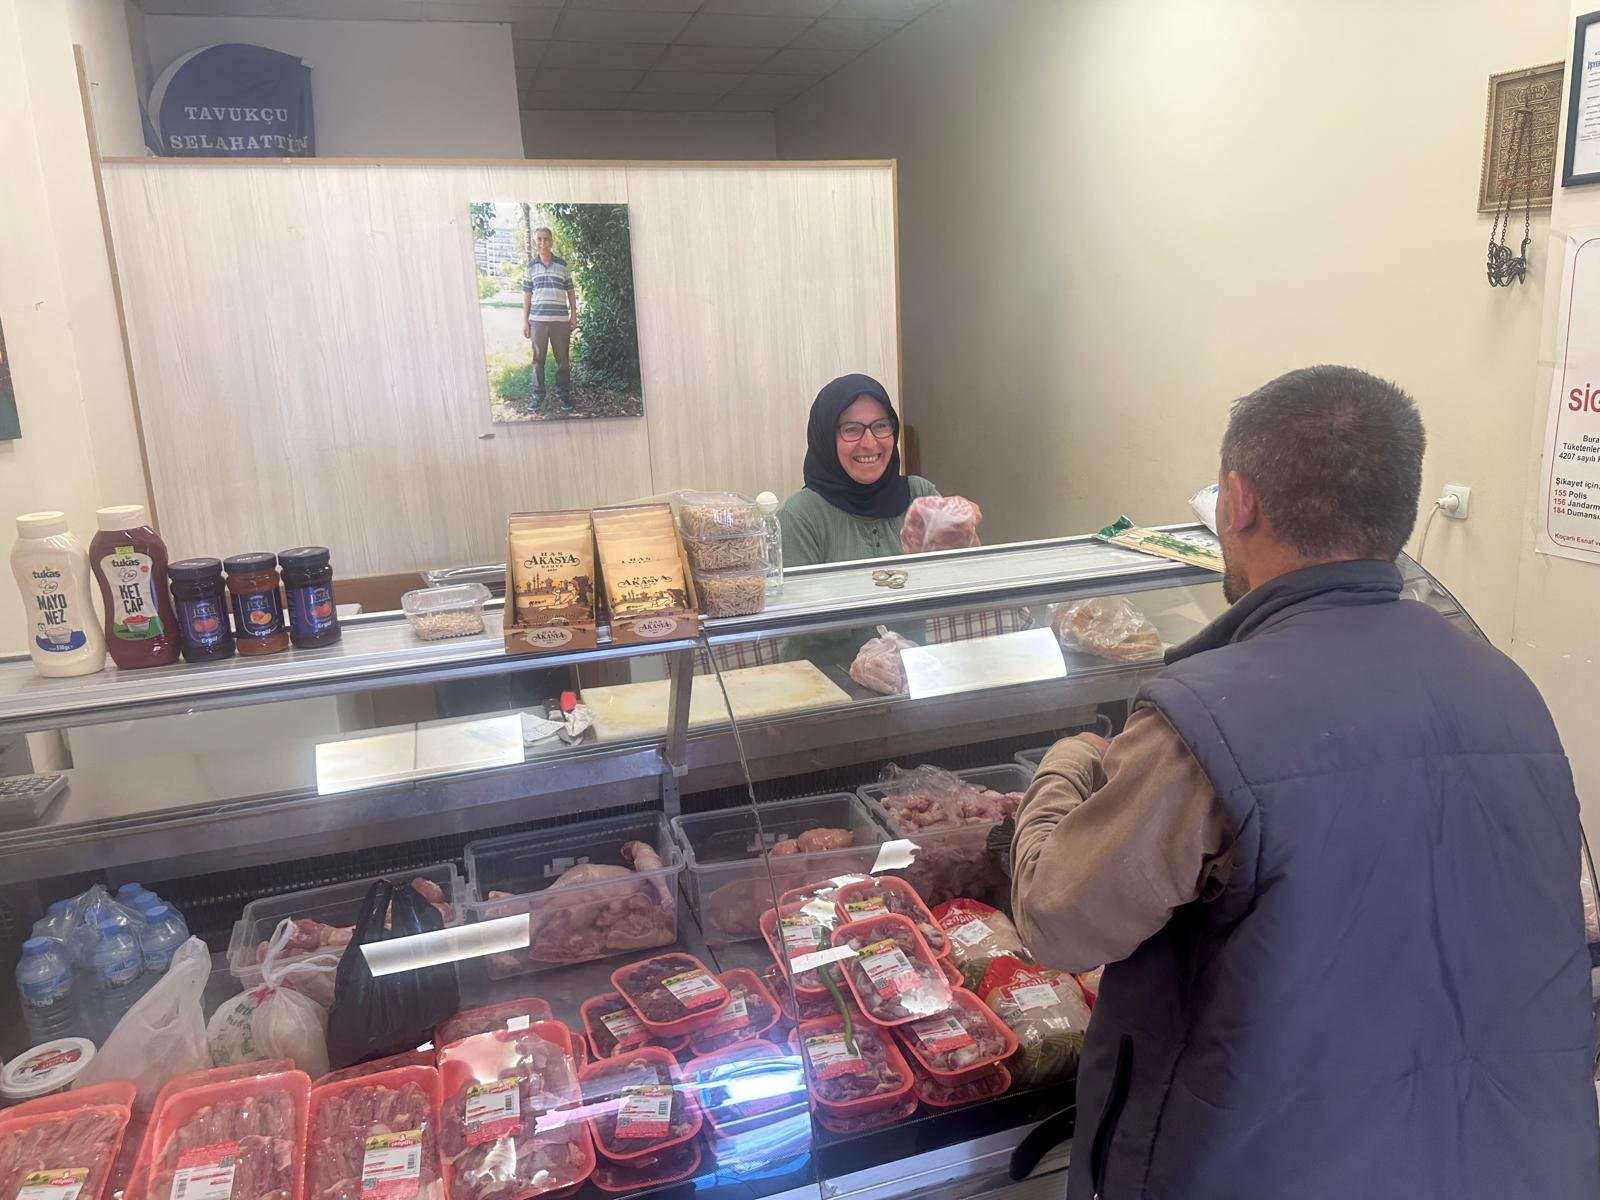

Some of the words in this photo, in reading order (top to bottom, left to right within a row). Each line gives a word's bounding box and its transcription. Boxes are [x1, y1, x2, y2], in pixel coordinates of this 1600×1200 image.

[184, 106, 288, 125] TAVUKÇU
[169, 133, 309, 153] SELAHATTİN
[1559, 452, 1576, 461] 4207
[1577, 455, 1596, 464] sayılı
[1555, 477, 1583, 488] Şikayet
[1554, 489, 1567, 497] 155
[1568, 490, 1588, 500] Polis
[1553, 498, 1566, 506] 156
[1553, 506, 1565, 514] 184
[1576, 536, 1595, 545] Esnaf
[525, 554, 579, 568] AKASYA
[119, 583, 140, 600] KET
[36, 593, 68, 611] MAYO
[123, 597, 144, 615] ÇAP
[44, 608, 68, 626] NEZ
[532, 631, 567, 642] AKASYA
